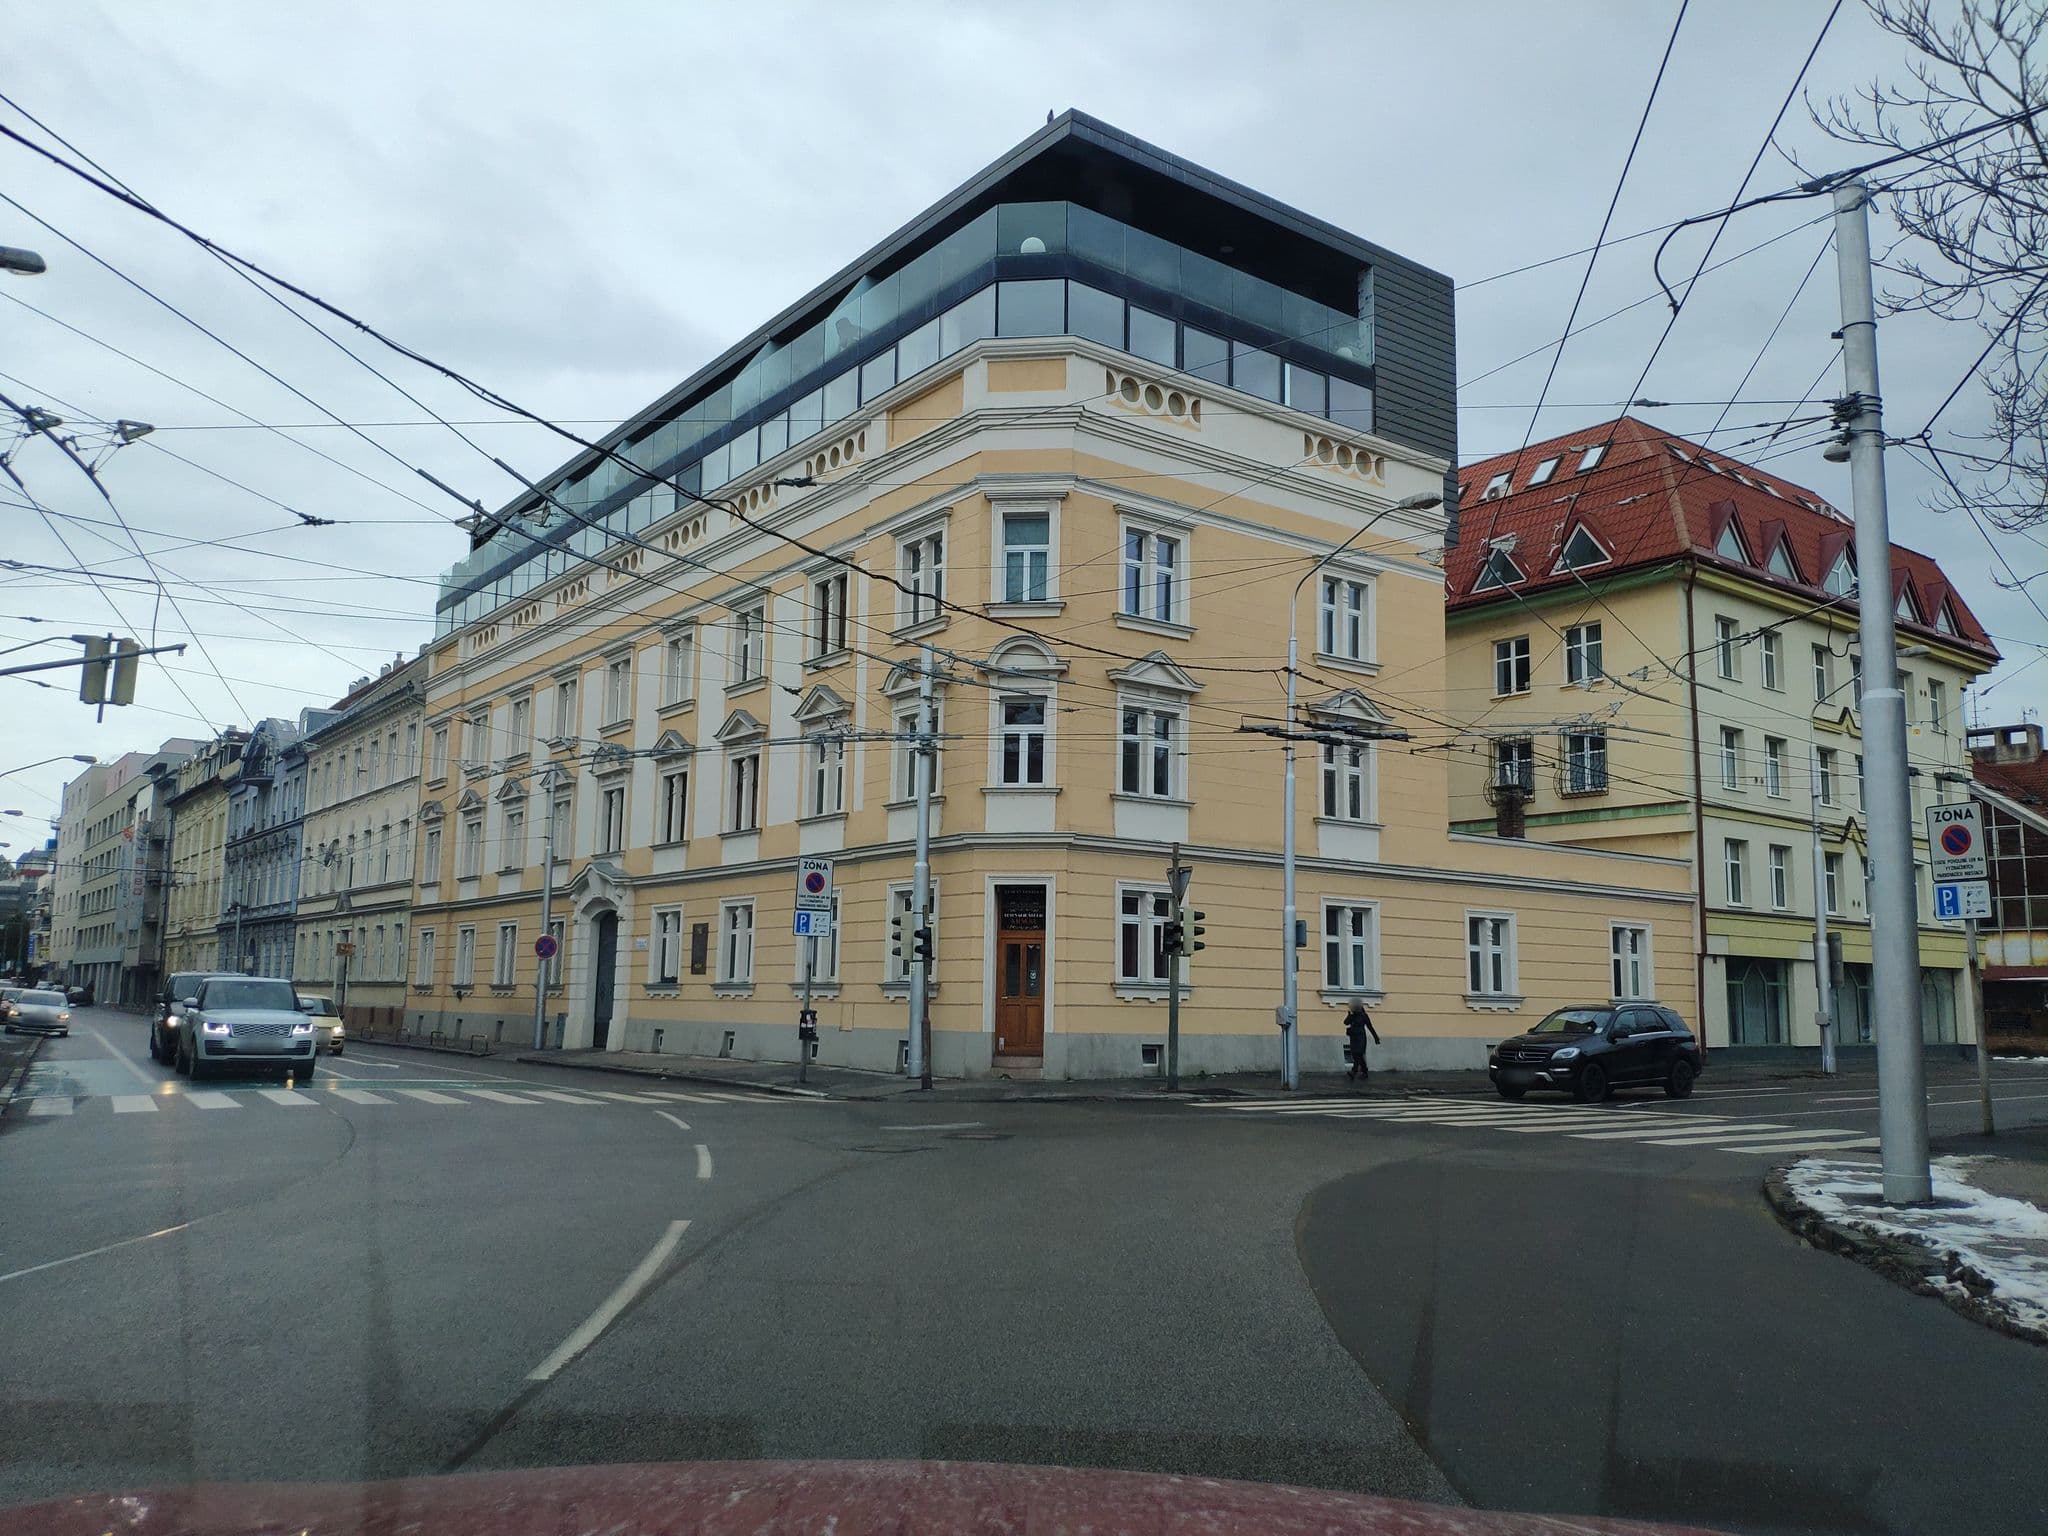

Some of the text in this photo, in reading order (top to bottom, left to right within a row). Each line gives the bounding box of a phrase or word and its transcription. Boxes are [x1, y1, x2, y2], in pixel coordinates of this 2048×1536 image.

[1934, 807, 1974, 823] ZÓNA
[803, 860, 829, 871] ZÓNA
[1942, 889, 1953, 907] P
[800, 914, 807, 928] P
